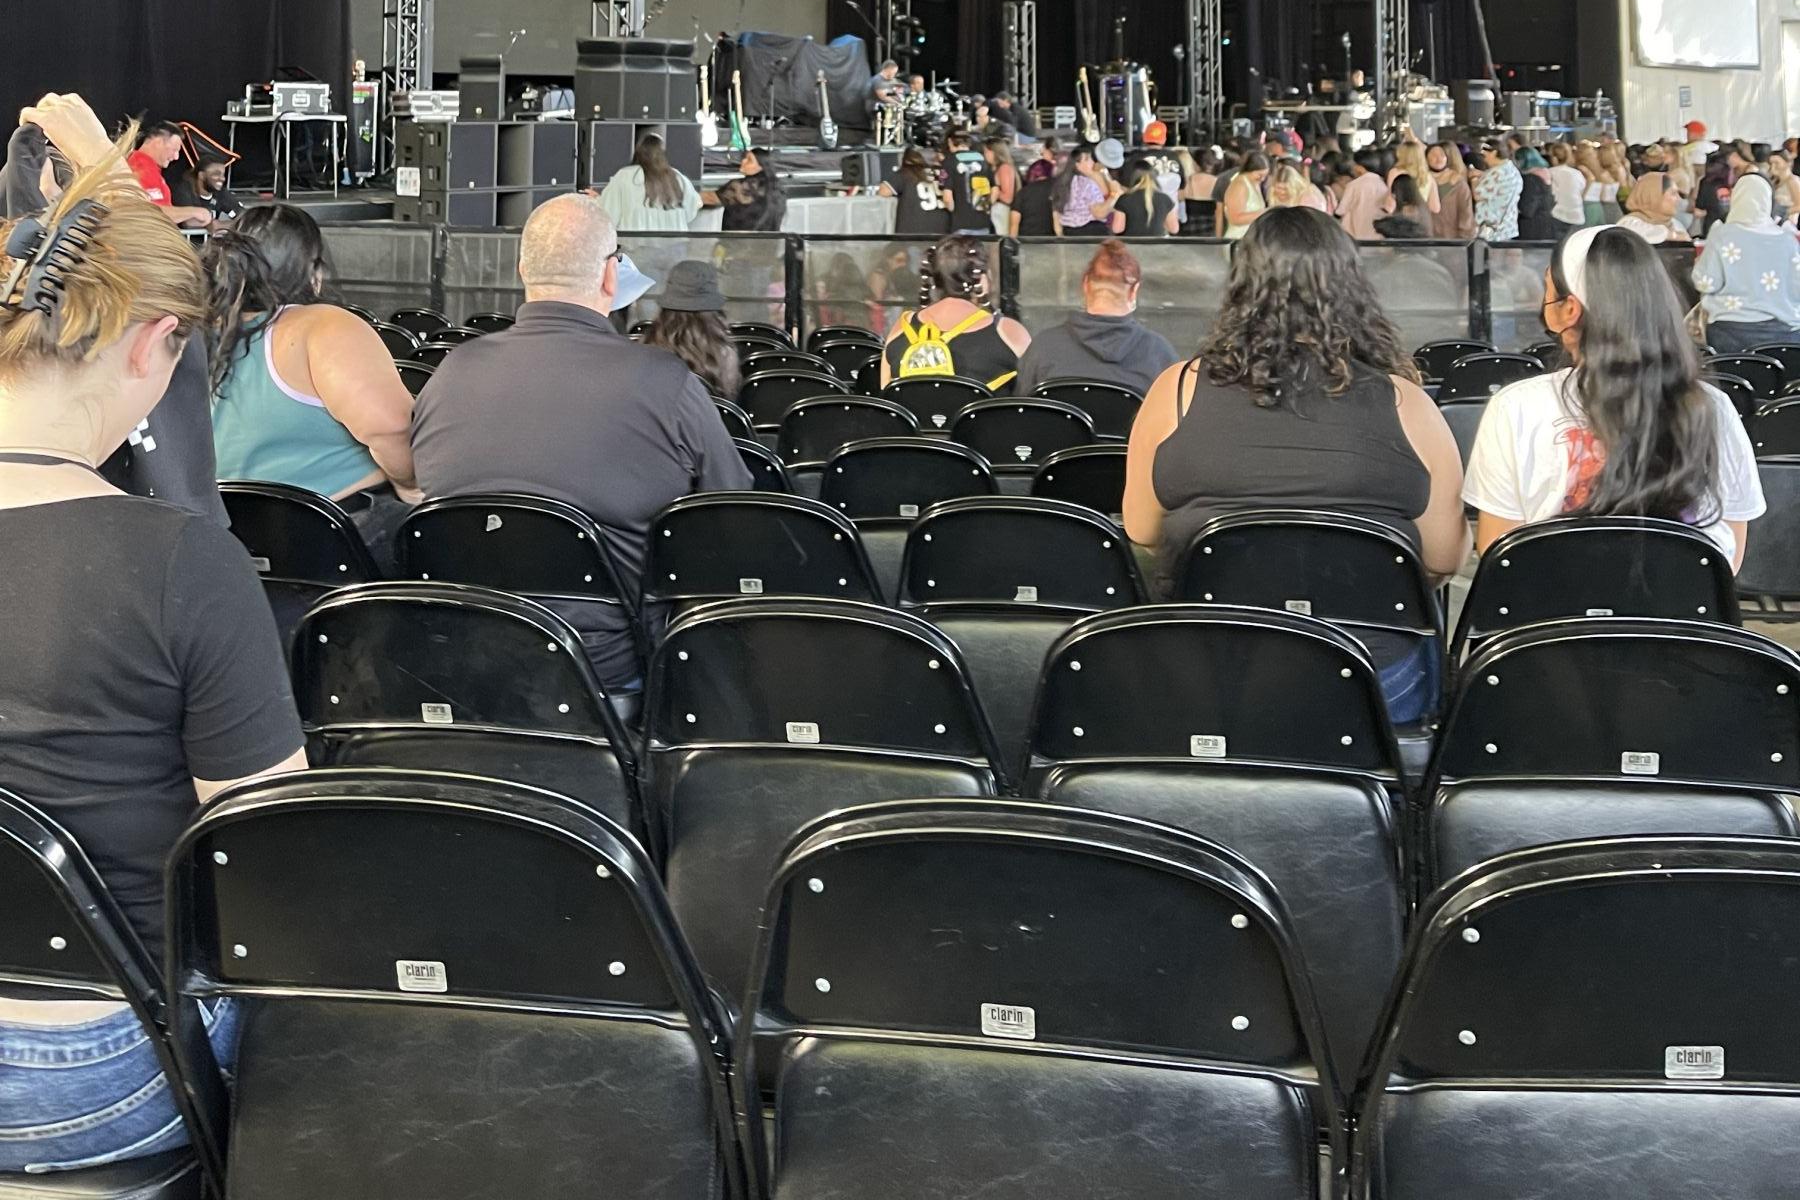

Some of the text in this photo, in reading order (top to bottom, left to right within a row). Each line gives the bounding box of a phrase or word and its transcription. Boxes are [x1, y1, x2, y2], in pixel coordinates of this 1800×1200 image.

[405, 964, 436, 977] clarin
[990, 1007, 1023, 1023] clarin
[1676, 1049, 1712, 1063] clarin
